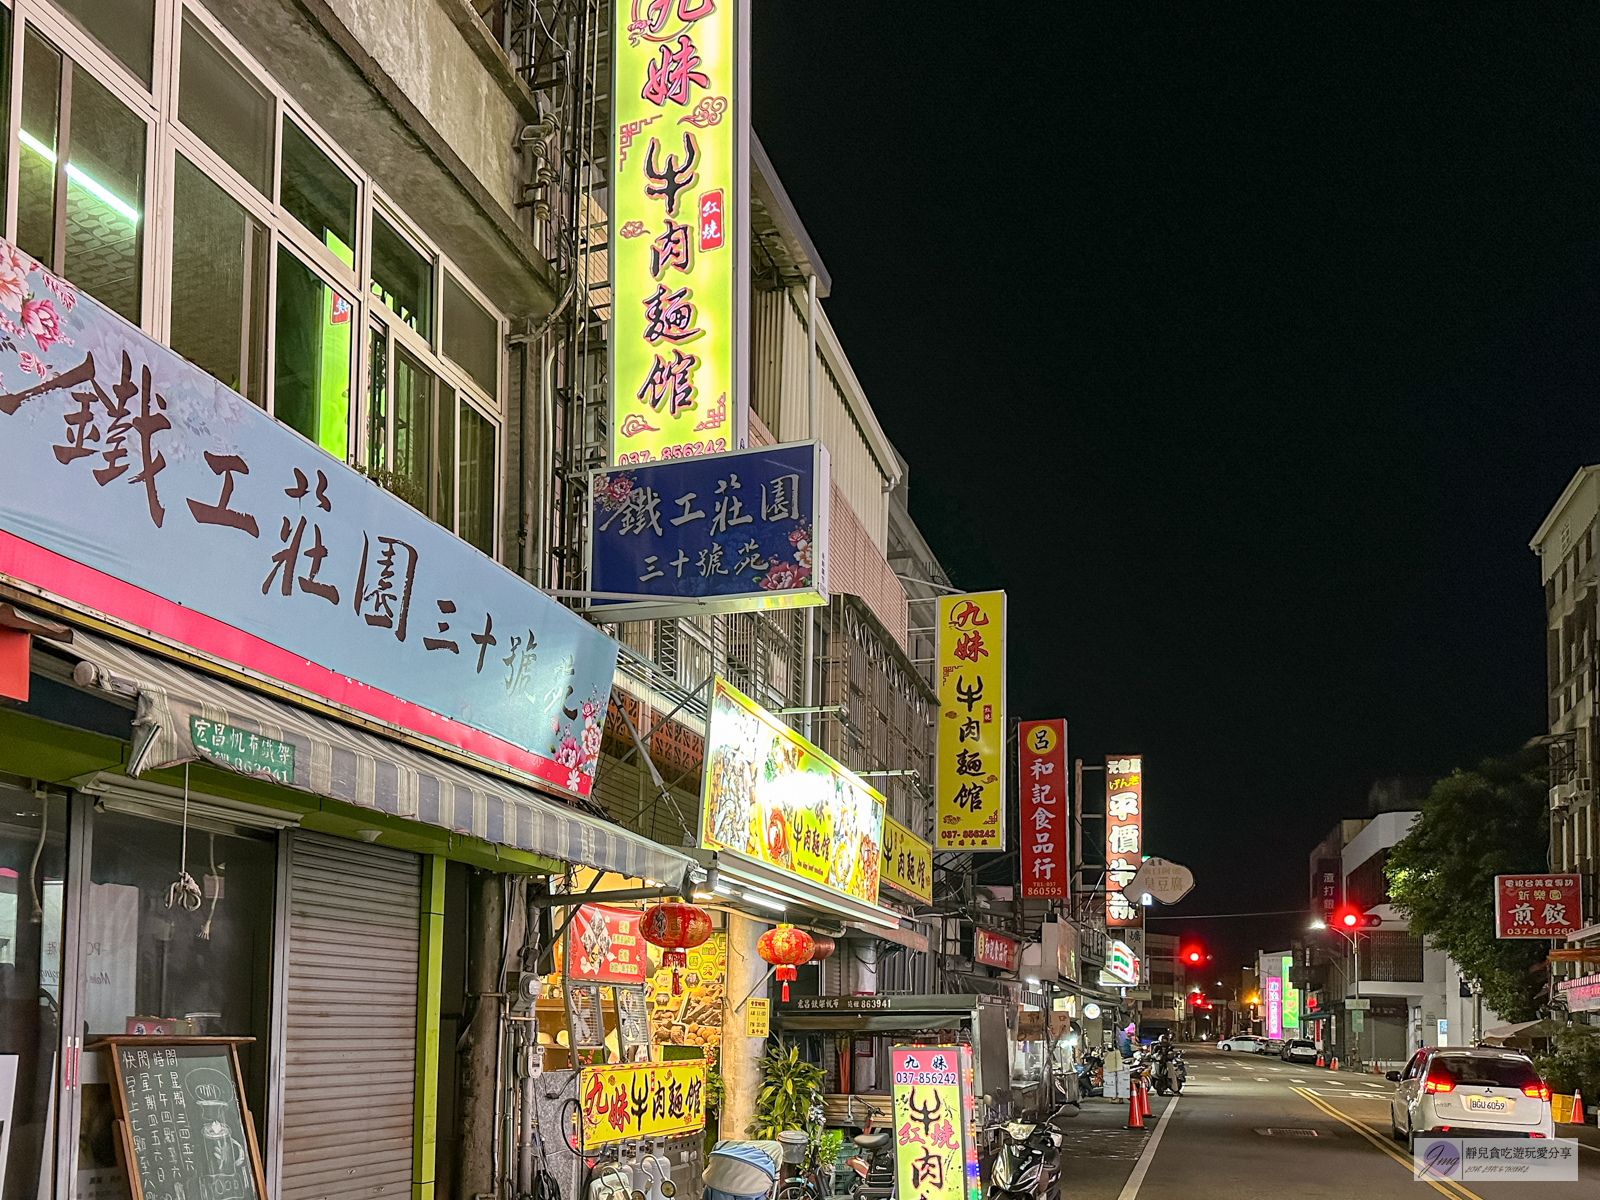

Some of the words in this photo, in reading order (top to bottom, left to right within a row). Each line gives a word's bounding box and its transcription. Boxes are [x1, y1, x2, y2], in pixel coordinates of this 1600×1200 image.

[599, 473, 800, 537] 鐵工莊園
[639, 538, 769, 582] 三十號苑
[1030, 758, 1056, 880] 和記食品行
[1028, 887, 1062, 896] 860595
[1518, 890, 1562, 900] 新樂園
[861, 999, 891, 1008] 863941
[123, 1049, 178, 1068] 快閃時間
[896, 1072, 956, 1084] 037-856242
